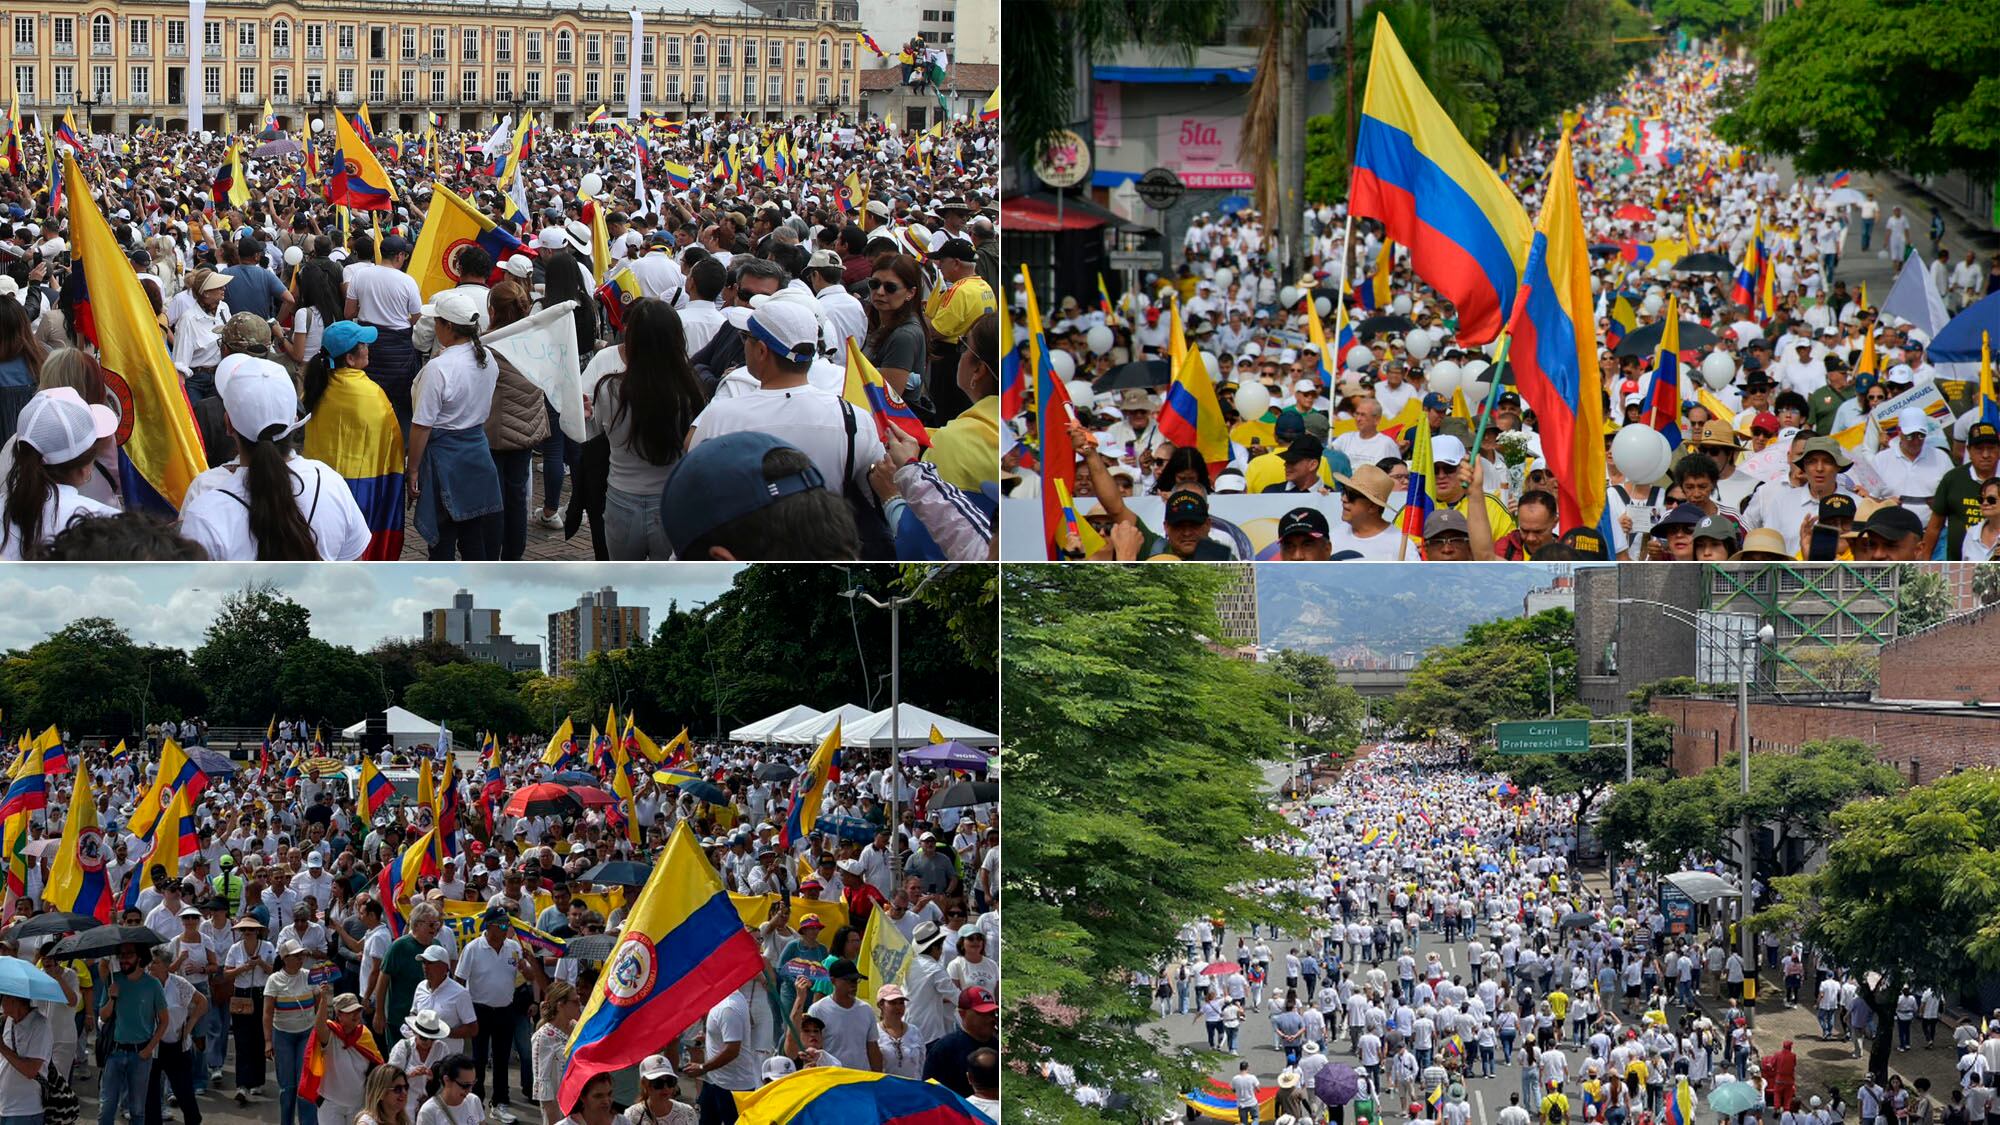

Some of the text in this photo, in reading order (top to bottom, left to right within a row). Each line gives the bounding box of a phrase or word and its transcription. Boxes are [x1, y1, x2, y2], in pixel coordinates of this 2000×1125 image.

[1179, 118, 1222, 146] 5ta.
[1188, 175, 1203, 186] DE
[1205, 174, 1252, 186] BELLEZA
[1529, 725, 1558, 736] Carril
[1502, 736, 1585, 750] Preferencial Bus
